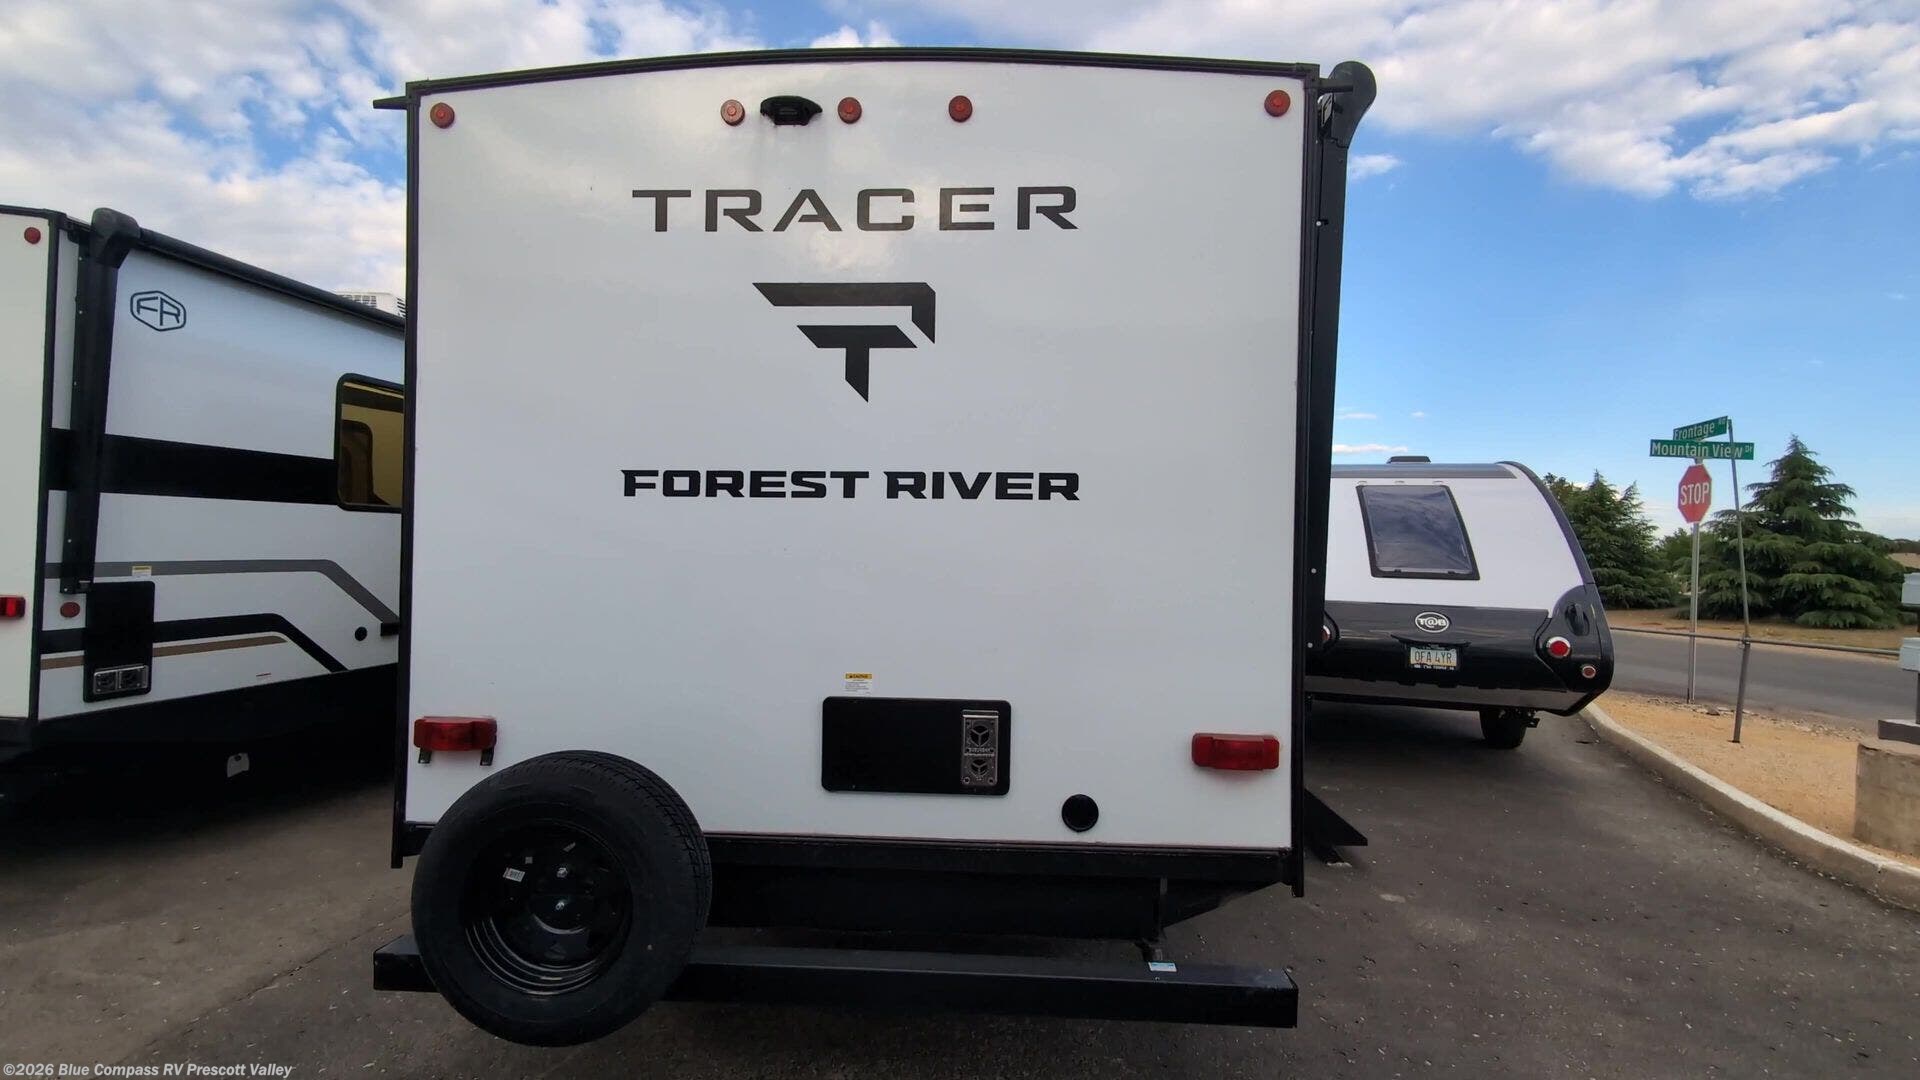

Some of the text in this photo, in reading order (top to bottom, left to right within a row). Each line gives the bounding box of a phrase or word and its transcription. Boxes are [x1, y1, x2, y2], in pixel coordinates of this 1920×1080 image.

[632, 186, 1078, 232] TRACER
[1674, 422, 1715, 440] Frontage
[1651, 442, 1709, 458] Mountain
[1712, 443, 1743, 458] View
[621, 469, 1080, 501] FOREST RIVER
[1680, 482, 1710, 506] STOP
